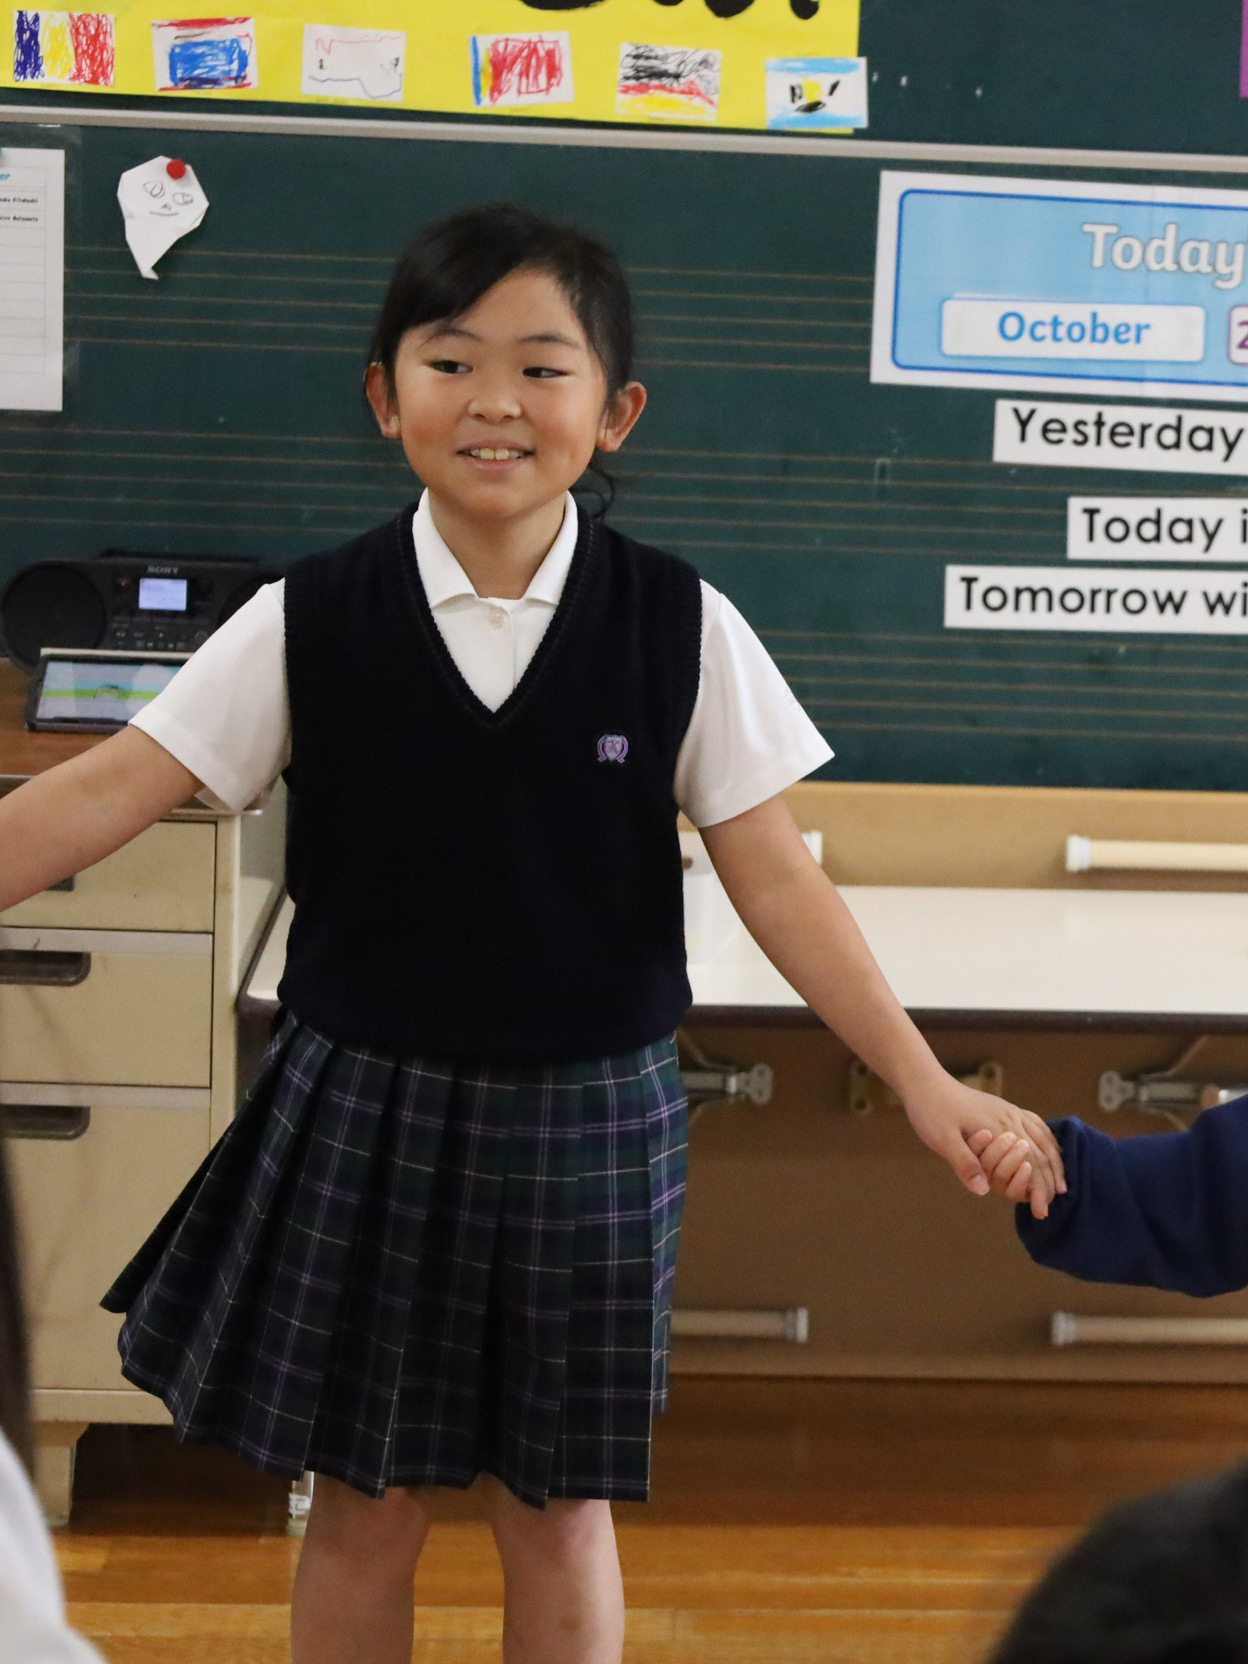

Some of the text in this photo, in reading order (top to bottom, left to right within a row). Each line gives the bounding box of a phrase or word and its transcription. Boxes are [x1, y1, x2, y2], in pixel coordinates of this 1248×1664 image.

[997, 311, 1151, 345] October
[1011, 407, 1245, 462] Yesterday
[1082, 507, 1224, 553] Today
[960, 576, 1188, 616] Tomorrow
